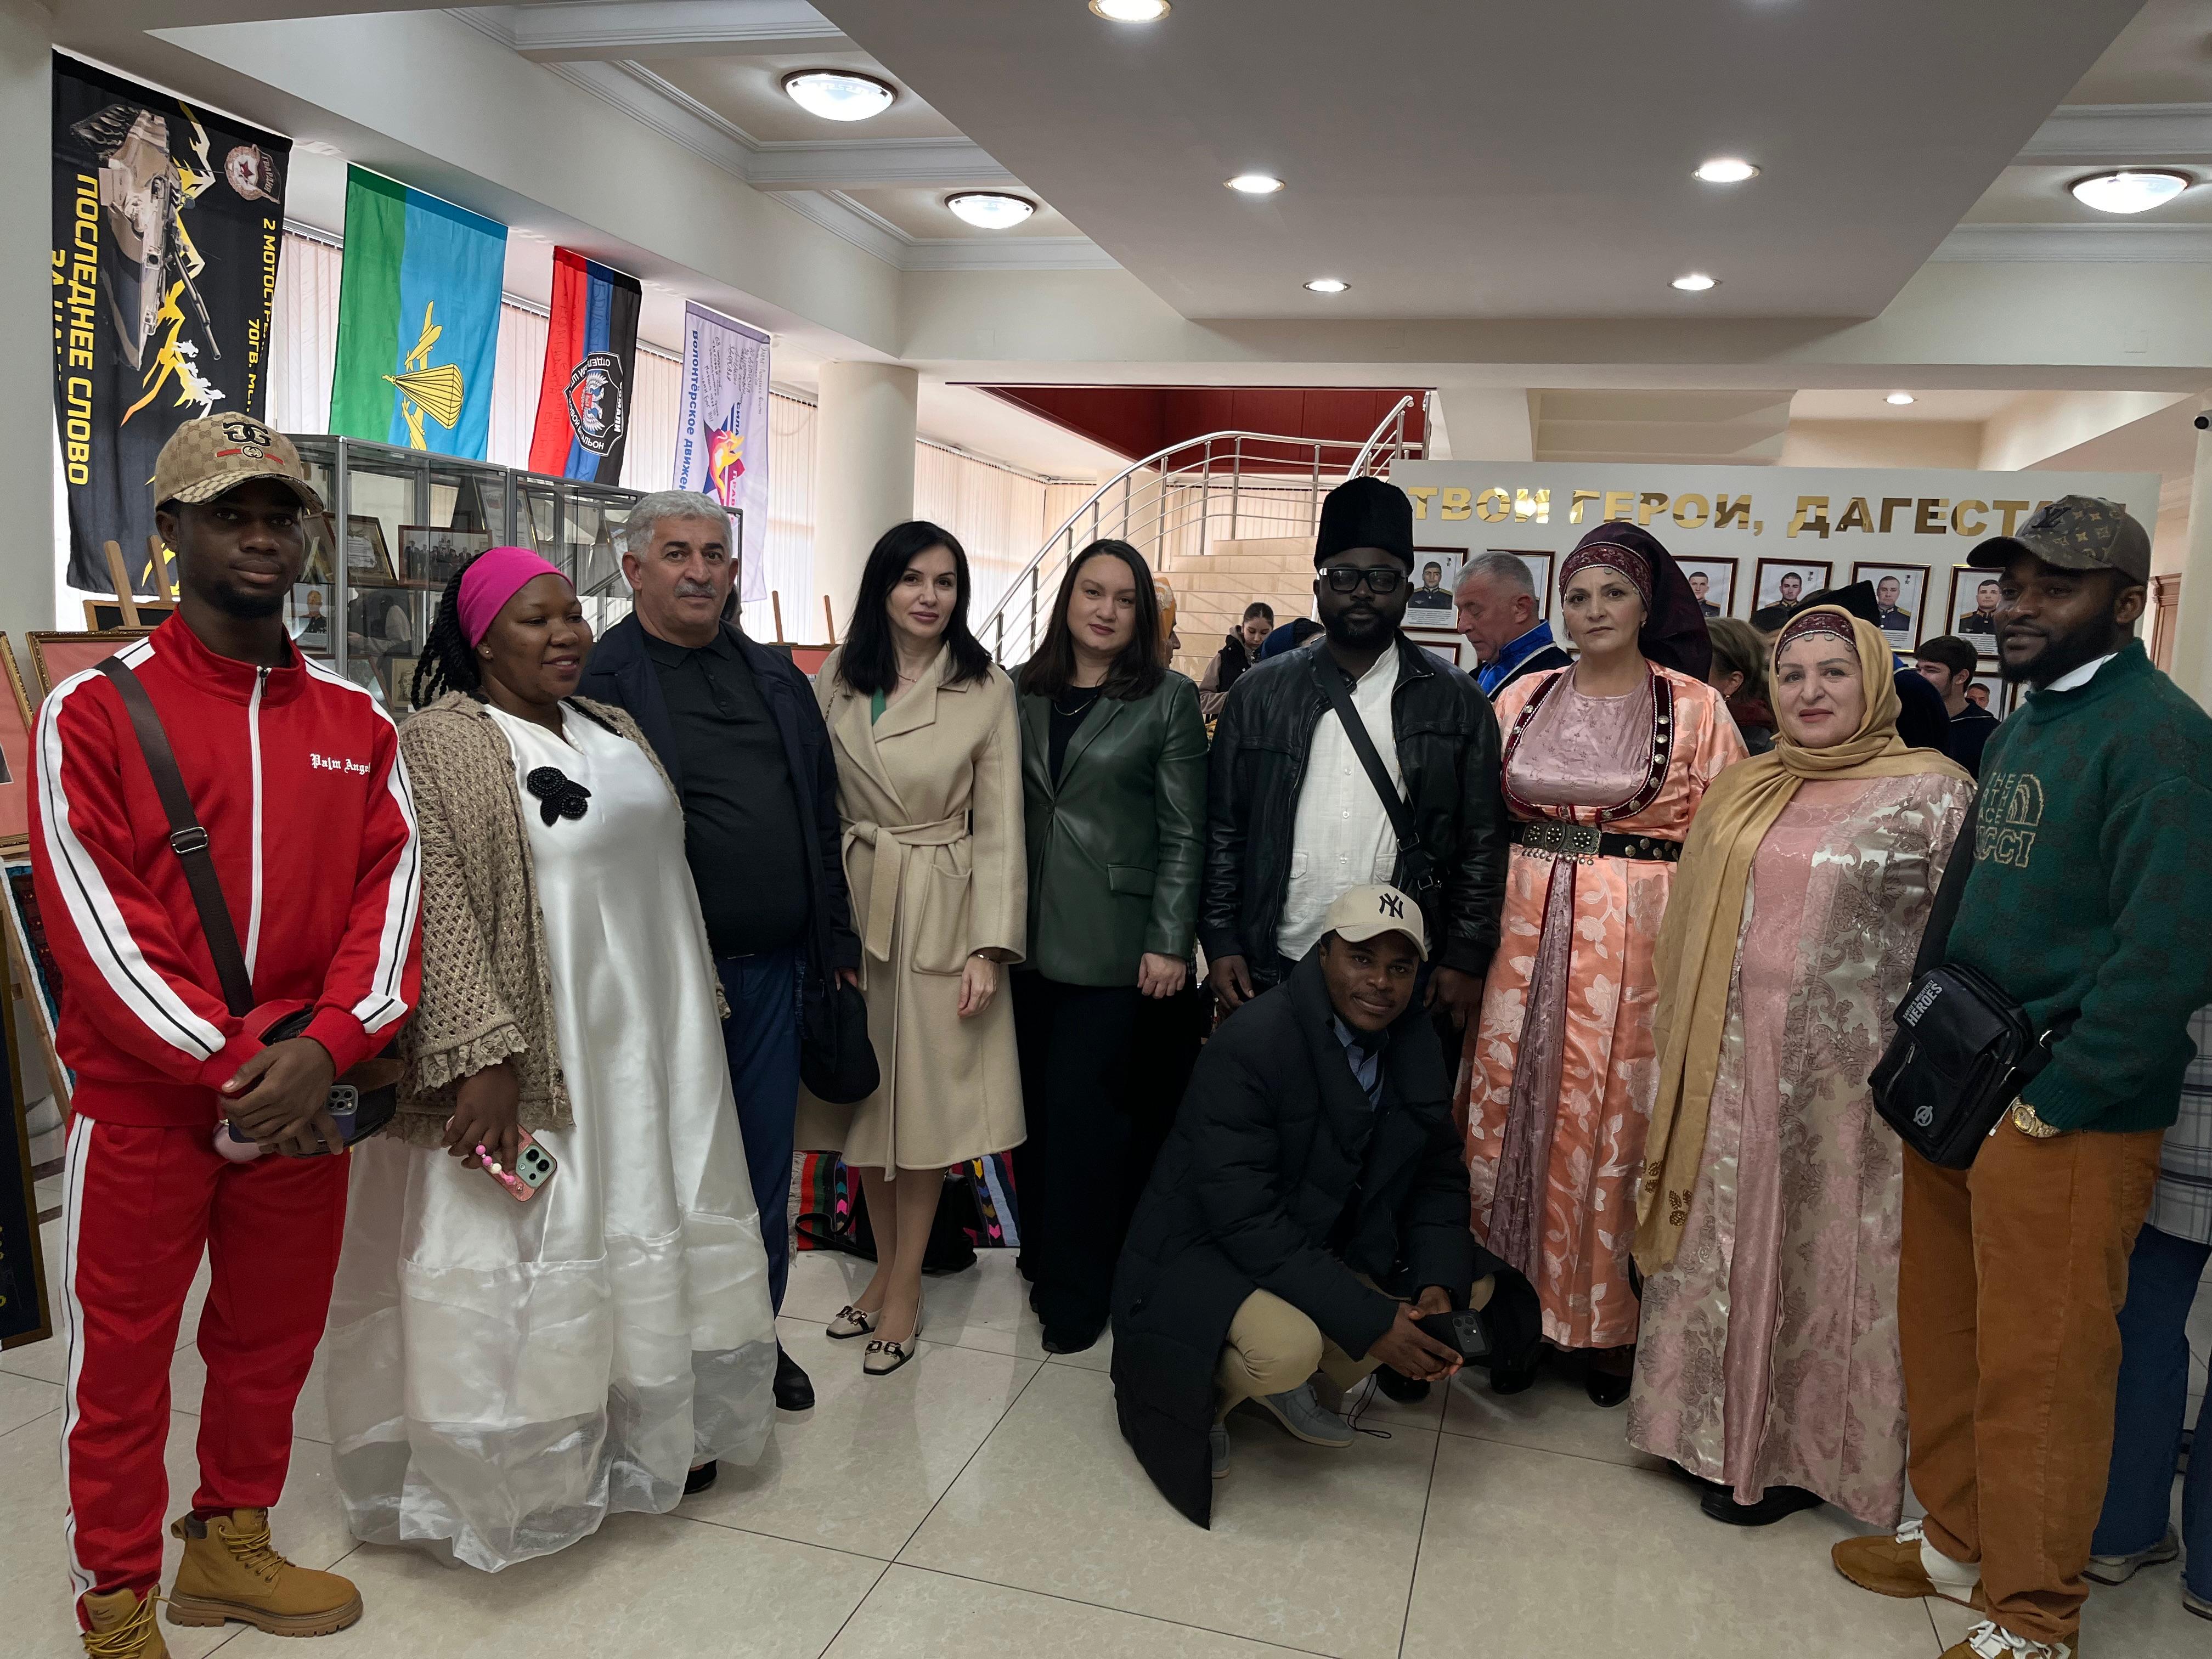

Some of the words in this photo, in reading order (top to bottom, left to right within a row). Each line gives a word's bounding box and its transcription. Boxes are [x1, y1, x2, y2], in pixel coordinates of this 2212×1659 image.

[263, 218, 275, 230] 2
[67, 173, 98, 370] ПОСЛЕДНЕЕ
[67, 376, 92, 486] СЛОВО
[1408, 487, 1550, 523] ТВОИ
[1570, 490, 1763, 537] ГЕРОИ,
[1787, 495, 2126, 539] ДАГЕСТ
[310, 753, 341, 770] Palm
[344, 759, 371, 775] Angel
[1977, 807, 2004, 824] ACE
[1906, 983, 1943, 1027] HEROES
